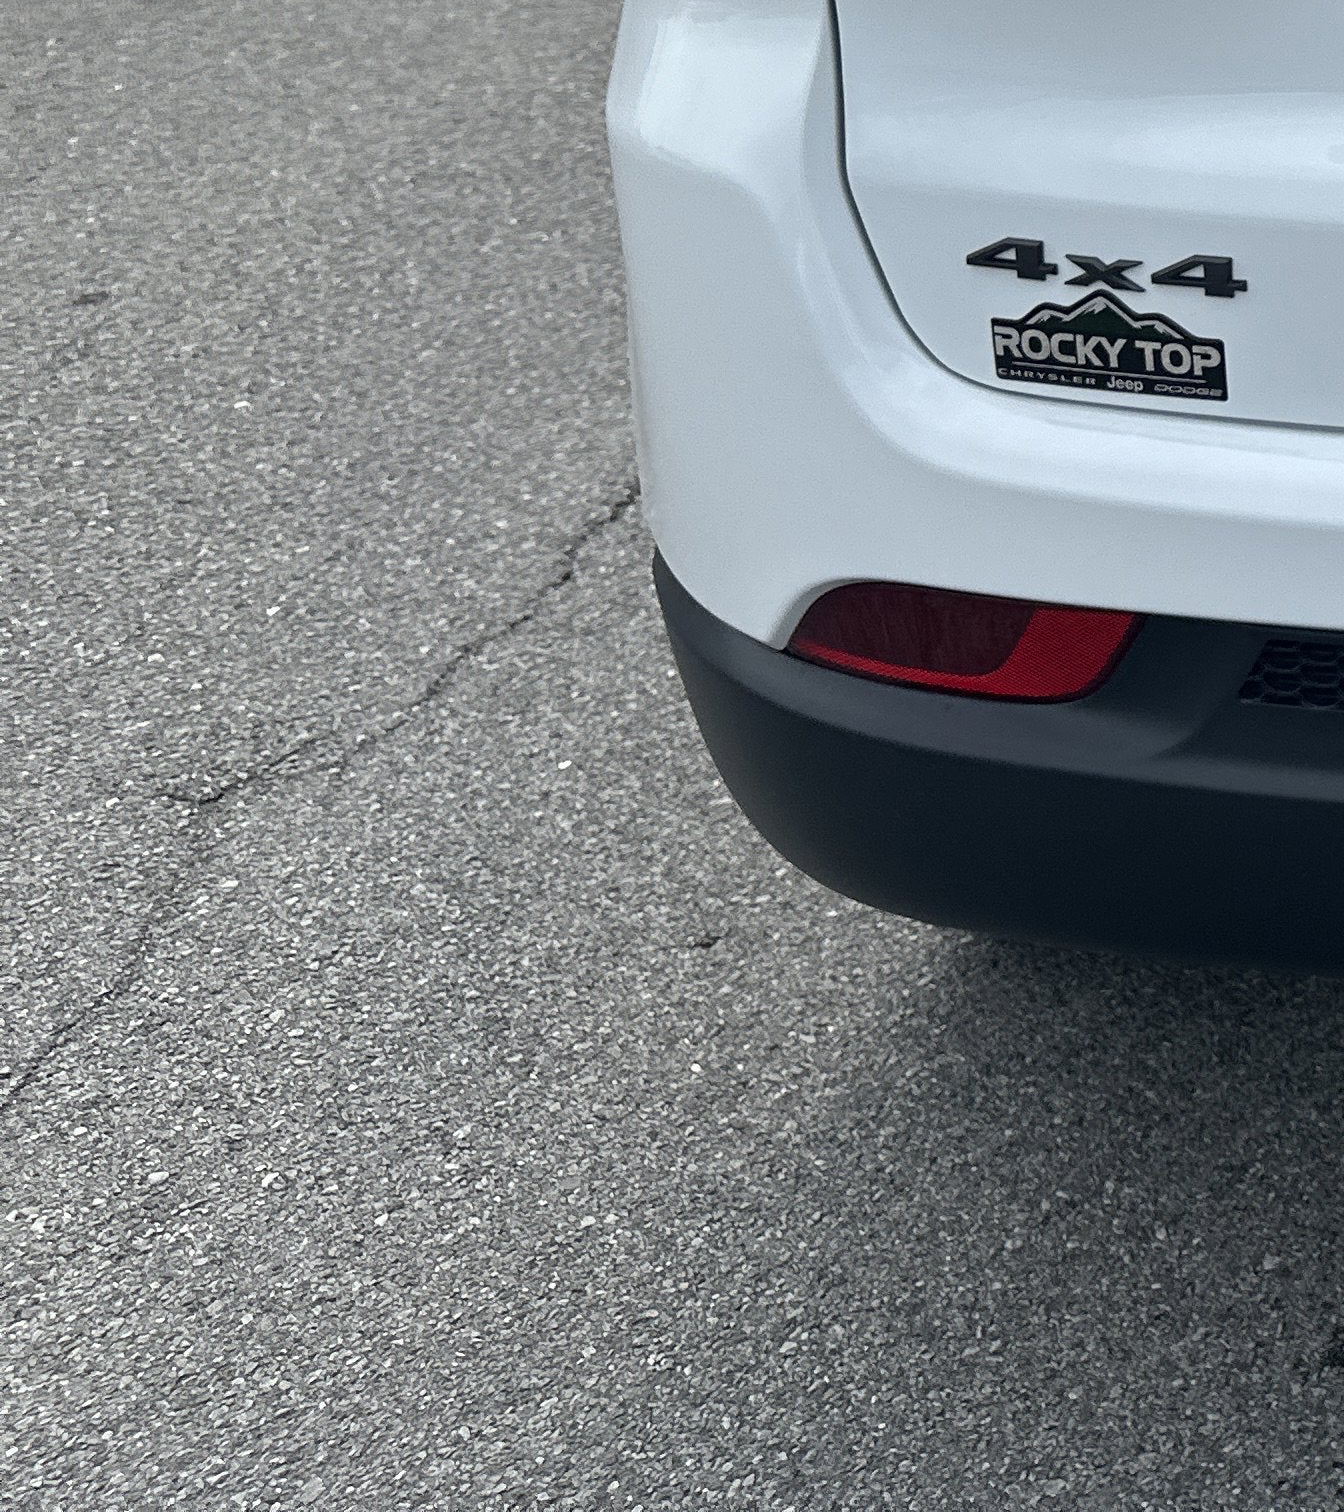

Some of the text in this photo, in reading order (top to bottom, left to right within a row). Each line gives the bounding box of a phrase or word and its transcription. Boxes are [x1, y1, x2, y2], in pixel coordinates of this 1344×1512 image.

[993, 325, 1222, 376] ROCKY TOP
[998, 368, 1223, 397] CHRYSLER Jeep DODGE
